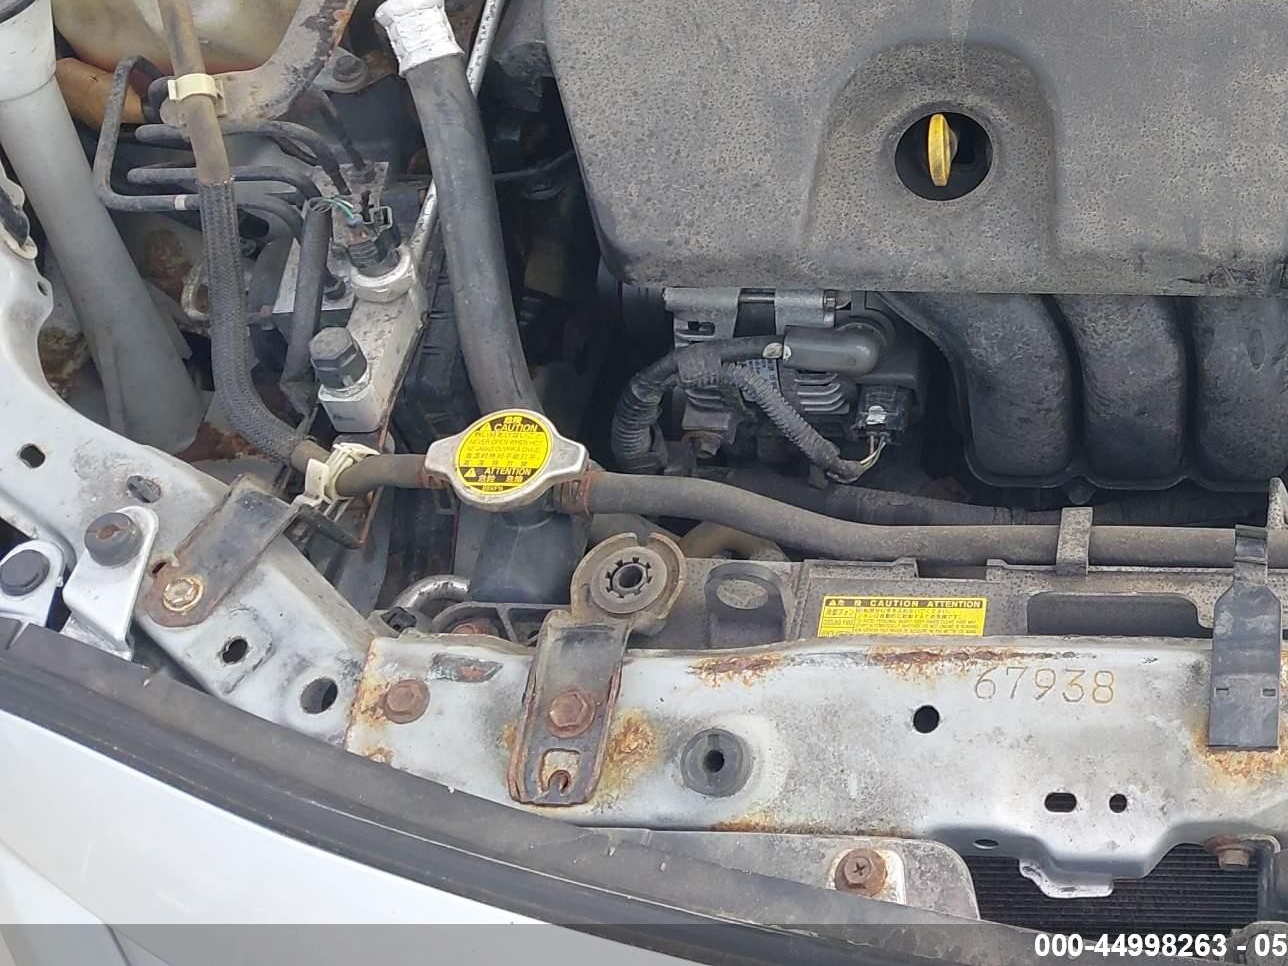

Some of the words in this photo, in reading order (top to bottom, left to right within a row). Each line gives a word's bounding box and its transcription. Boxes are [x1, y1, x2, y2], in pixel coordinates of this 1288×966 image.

[494, 424, 538, 432] CAUTION
[484, 467, 531, 476] ATTENTION
[927, 600, 981, 608] ATTENTION
[974, 665, 1115, 704] 67938
